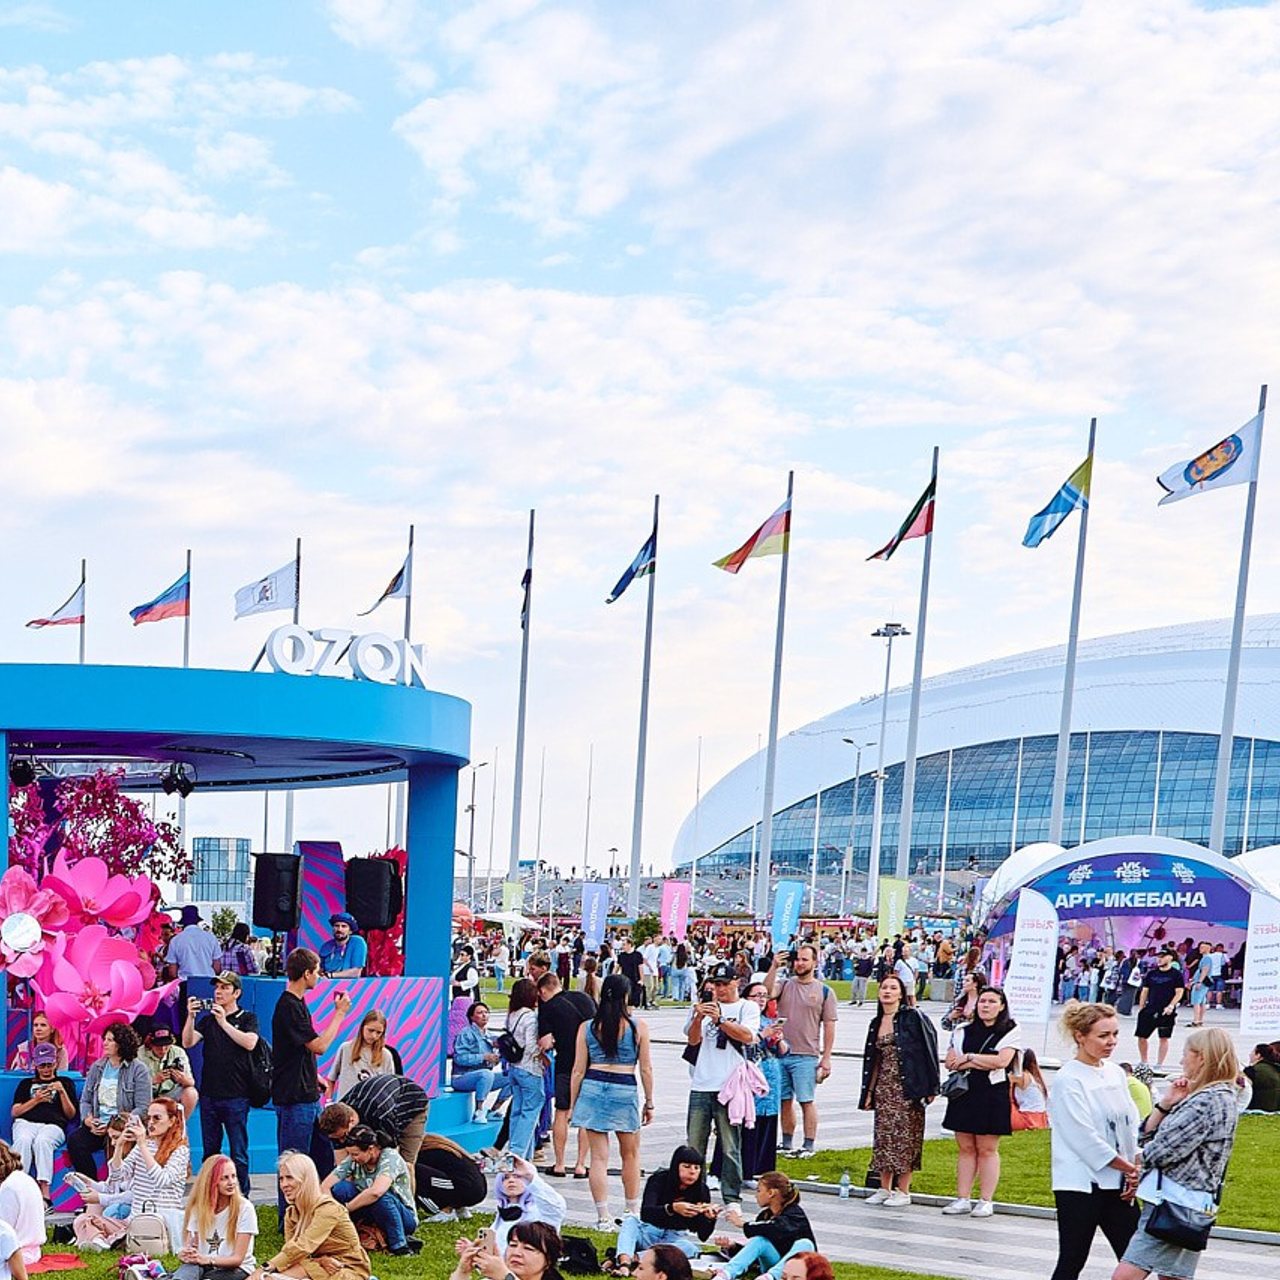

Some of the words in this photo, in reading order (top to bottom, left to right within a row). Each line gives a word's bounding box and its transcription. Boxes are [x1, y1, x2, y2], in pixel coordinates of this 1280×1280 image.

[267, 624, 429, 689] OZON
[1113, 866, 1150, 878] fest
[1122, 861, 1141, 869] VK
[1055, 892, 1208, 909] АРТ-ИКЕБАНА
